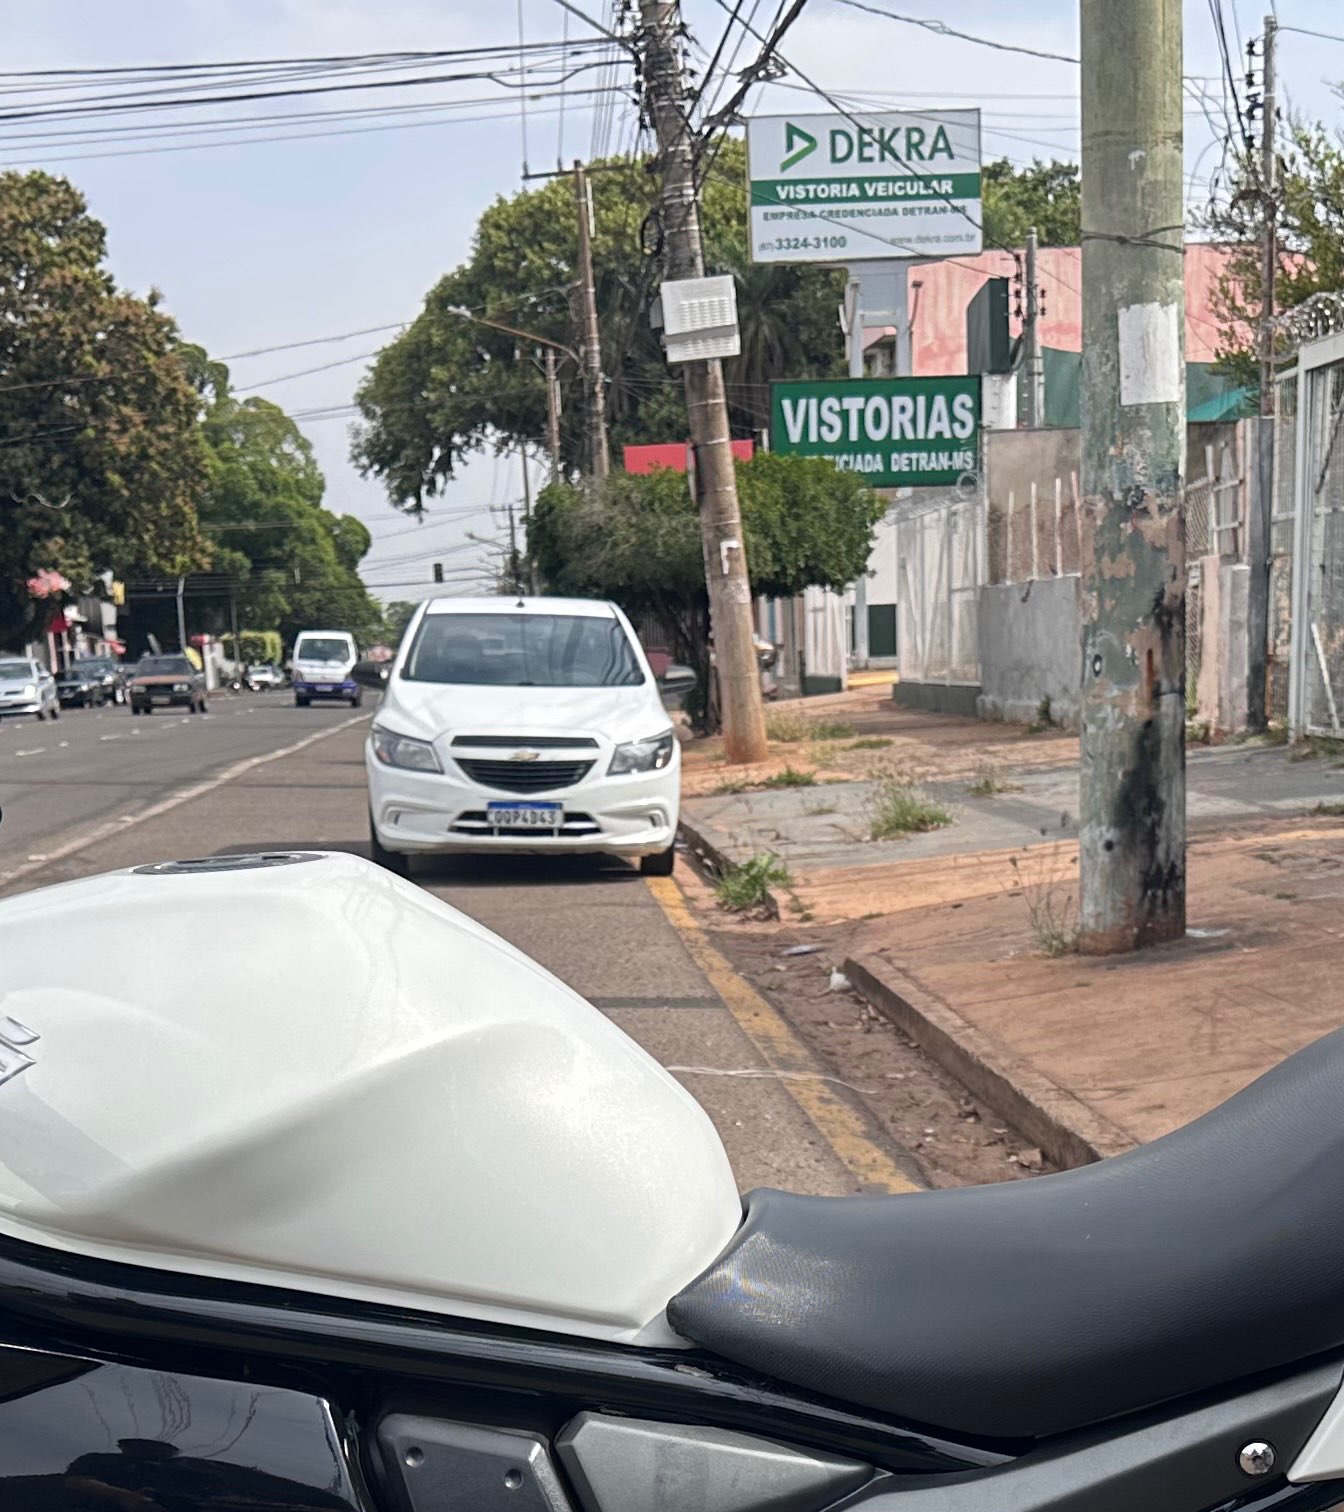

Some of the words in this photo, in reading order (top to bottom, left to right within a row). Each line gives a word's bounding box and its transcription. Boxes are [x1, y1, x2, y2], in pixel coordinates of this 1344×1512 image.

[829, 124, 955, 164] DEKRA
[776, 182, 861, 200] VISTORIA
[864, 180, 954, 197] VEICULAR
[763, 210, 816, 221] EMPRESA
[819, 207, 899, 218] CREDENCIADA
[902, 204, 967, 216] DETRAN-MS
[781, 393, 975, 443] VISTORIAS
[890, 450, 974, 473] DETRAN-MS
